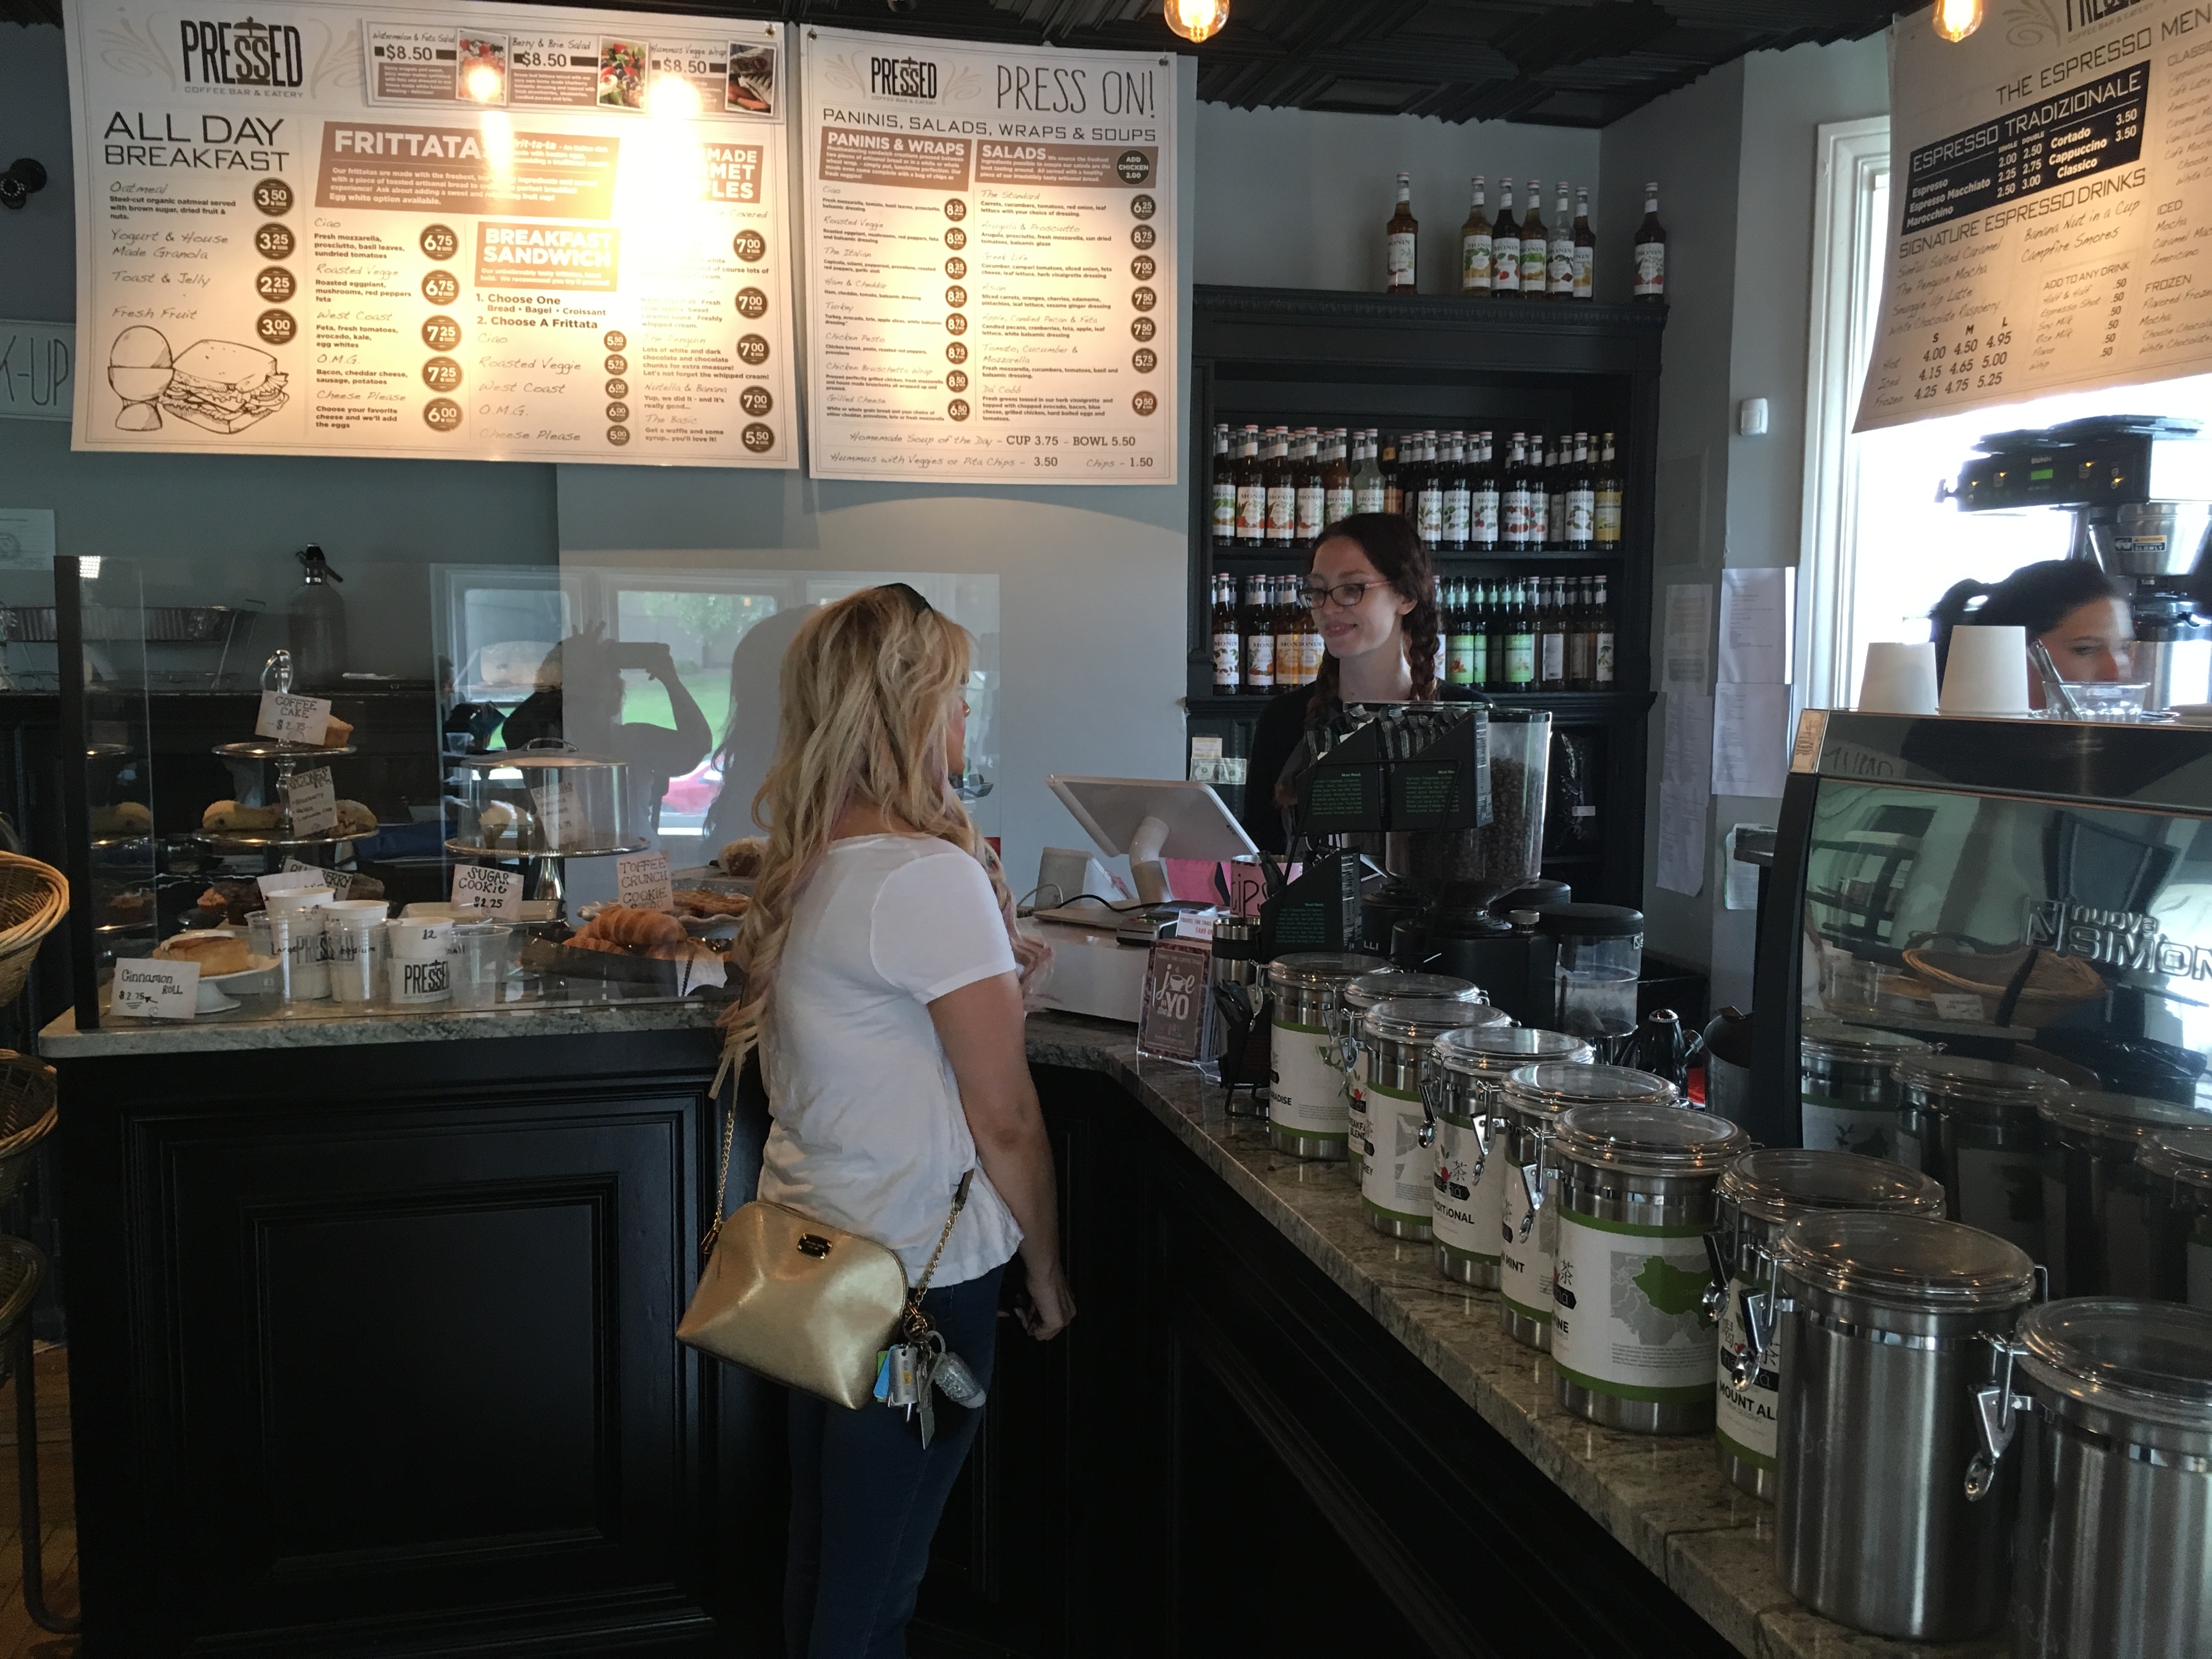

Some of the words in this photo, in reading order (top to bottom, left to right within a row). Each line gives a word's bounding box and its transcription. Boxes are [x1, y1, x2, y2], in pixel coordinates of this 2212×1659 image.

[180, 18, 303, 87] PRESSED
[512, 38, 534, 50] Berry
[538, 38, 545, 47] &
[549, 39, 564, 49] Brie
[569, 40, 591, 50] Salad
[386, 45, 432, 61] $8.50
[521, 53, 566, 67] $8.50
[1996, 75, 2032, 105] THE
[2041, 28, 2152, 89] ESPRESSO
[2162, 7, 2212, 43] MEN
[871, 57, 936, 99] PRESSED
[185, 86, 226, 95] COFFEE
[230, 88, 250, 96] BAR
[264, 90, 303, 98] EATERY
[997, 65, 1086, 112] PRESS
[1102, 70, 1154, 119] ON!
[104, 111, 190, 142] ALL
[203, 115, 284, 146] DAY
[823, 108, 904, 129] PANINIS,
[910, 118, 992, 136] SALADS,
[999, 123, 1066, 139] WRAPS
[1073, 128, 1085, 139] &
[1092, 129, 1155, 142] SOUPS
[1912, 126, 1999, 172] ESPRESSO
[2005, 70, 2141, 137] TRADIZIONALE
[2051, 127, 2090, 149] Cortado
[2115, 109, 2137, 126] 3.50
[828, 132, 890, 149] PANINIS
[894, 137, 905, 150] &
[907, 139, 964, 156] WRAPS
[1999, 141, 2018, 153] SINGLE
[2022, 131, 2045, 145] DOUBLE
[2049, 137, 2107, 166] Cappuccino
[2115, 126, 2136, 142] 3.50
[105, 145, 290, 172] BREAKFAST
[982, 145, 1046, 160] SALADS
[1912, 177, 1948, 198] Espresso
[1999, 153, 2017, 167] 2.00
[2023, 143, 2042, 159] 2.50
[2057, 157, 2097, 179] Classico
[111, 181, 168, 194] Oatmeal
[1909, 193, 1946, 214] Espresso
[1948, 178, 1991, 202] Macchiato
[1998, 167, 2016, 182] 2.25
[2023, 160, 2042, 174] 2.75
[145, 197, 174, 207] organic
[258, 189, 286, 206] 3.50
[1906, 205, 1954, 228] Marocchino
[1997, 183, 2016, 198] 2.50
[2022, 175, 2041, 189] 3.00
[1134, 201, 1152, 213] 6.25
[1899, 224, 1979, 258] SIGNATURE
[1984, 192, 2075, 232] ESPRESSO
[2078, 168, 2146, 206] DRINKS
[2157, 199, 2183, 215] ICED
[111, 228, 158, 244] Yogurt
[165, 232, 174, 241] &
[181, 232, 228, 244] House
[259, 234, 288, 251] 3.25
[425, 235, 453, 251] 6.75
[486, 229, 613, 249] BREAKFAST
[112, 246, 146, 258] Made
[153, 246, 208, 259] Granola
[737, 238, 760, 253] 7.00
[483, 246, 611, 267] SANDWICH
[112, 270, 154, 284] Toast
[161, 274, 170, 284] &
[178, 273, 211, 287] Jelly
[2043, 278, 2063, 290] ADD
[2064, 274, 2076, 285] TO
[2079, 269, 2099, 281] ANY
[2100, 261, 2130, 278] DRINK
[2145, 274, 2192, 292] FROZEN
[261, 277, 289, 294] 2.25
[488, 294, 533, 304] Choose
[537, 296, 560, 304] One
[111, 307, 153, 319] Fresh
[160, 308, 197, 320] Fruit
[487, 304, 514, 313] Bread
[525, 306, 552, 315] Bagel
[562, 307, 606, 315] Croissant
[262, 319, 290, 335] 3.00
[491, 317, 537, 327] Choose
[539, 318, 549, 327] A
[551, 319, 597, 329] Frittata
[1932, 333, 1939, 343] S
[1966, 324, 1974, 335] M
[2001, 317, 2007, 326] L
[428, 326, 455, 342] 7.25
[607, 336, 623, 346] 5.50
[1923, 346, 1946, 362] 4.00
[1954, 339, 1978, 355] 4.50
[1987, 331, 2012, 348] 4.95
[1135, 398, 1153, 409] 9.50
[850, 432, 904, 444] Homemade
[907, 434, 935, 448] Soup
[939, 436, 949, 448] of
[953, 436, 971, 444] the
[974, 437, 992, 449] Day
[1007, 436, 1031, 447] CUP
[1034, 436, 1058, 447] 3.75
[1073, 436, 1108, 447] BOWL
[1111, 436, 1136, 447] 5.50
[881, 455, 905, 465] with
[909, 455, 943, 469] Veggies
[963, 456, 983, 466] Pita
[986, 457, 1015, 469] Chips
[1034, 456, 1058, 467] 3.50
[1086, 458, 1115, 470] Chips
[1130, 457, 1153, 467] 1.50
[275, 696, 317, 711] COFFEE
[280, 707, 309, 719] CAKE
[619, 858, 667, 872] TOFFEE
[467, 867, 509, 885] SUGAR
[621, 872, 668, 887] CRUNCH
[623, 888, 667, 902] COOKIE
[2072, 907, 2159, 933] nuova
[422, 929, 437, 939] 12
[122, 969, 173, 984] Cinnamon
[162, 985, 183, 995] ROLL
[1505, 1255, 1525, 1273] MINT
[1719, 1384, 1753, 1413] MOUNT
